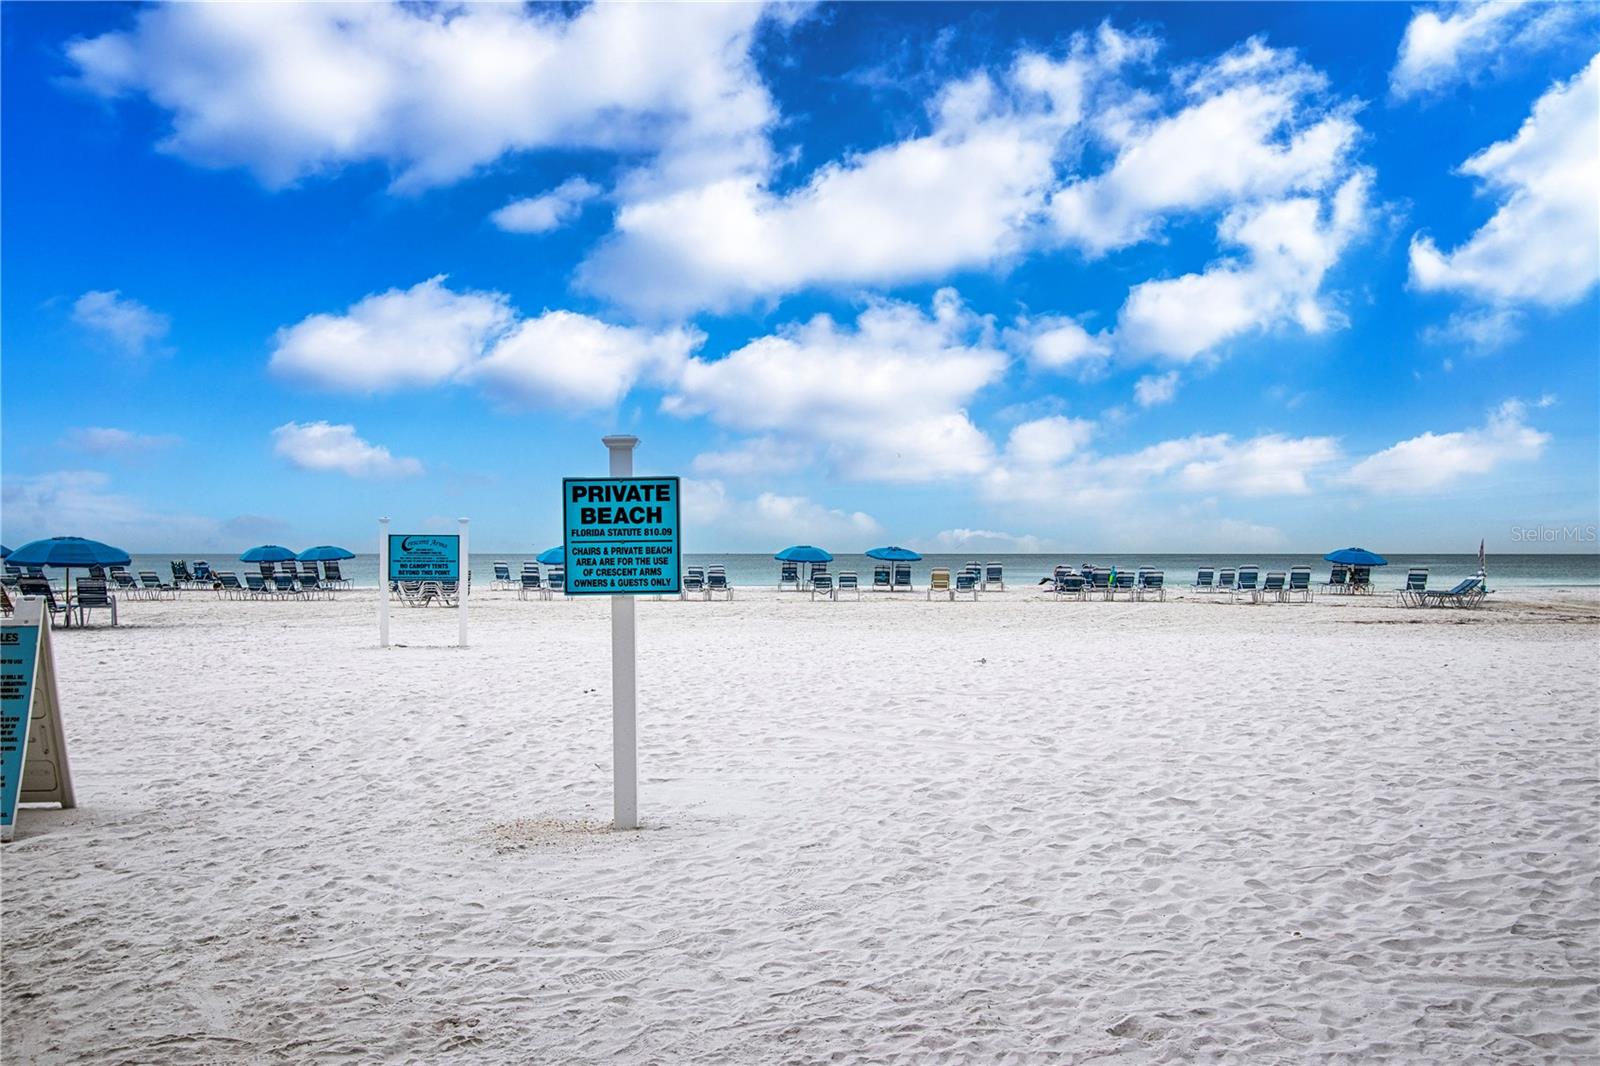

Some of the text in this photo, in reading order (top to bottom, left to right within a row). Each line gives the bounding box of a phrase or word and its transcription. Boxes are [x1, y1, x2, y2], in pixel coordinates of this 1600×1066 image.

[572, 485, 670, 502] PRIVATE
[581, 507, 662, 524] BEACH
[571, 528, 672, 537] FLORIDA STATUTE 810.09
[401, 536, 448, 551] Crescent Arms
[572, 546, 672, 555] CHAIRS & PRIVATE BEACH
[576, 558, 597, 566] AREA
[599, 558, 615, 566] ARE
[635, 557, 651, 565] THE
[653, 557, 669, 565] USE
[595, 568, 637, 576] CRESCENT
[639, 568, 662, 576] ARMS
[574, 578, 671, 587] OWNERS & GUESTS ONLY
